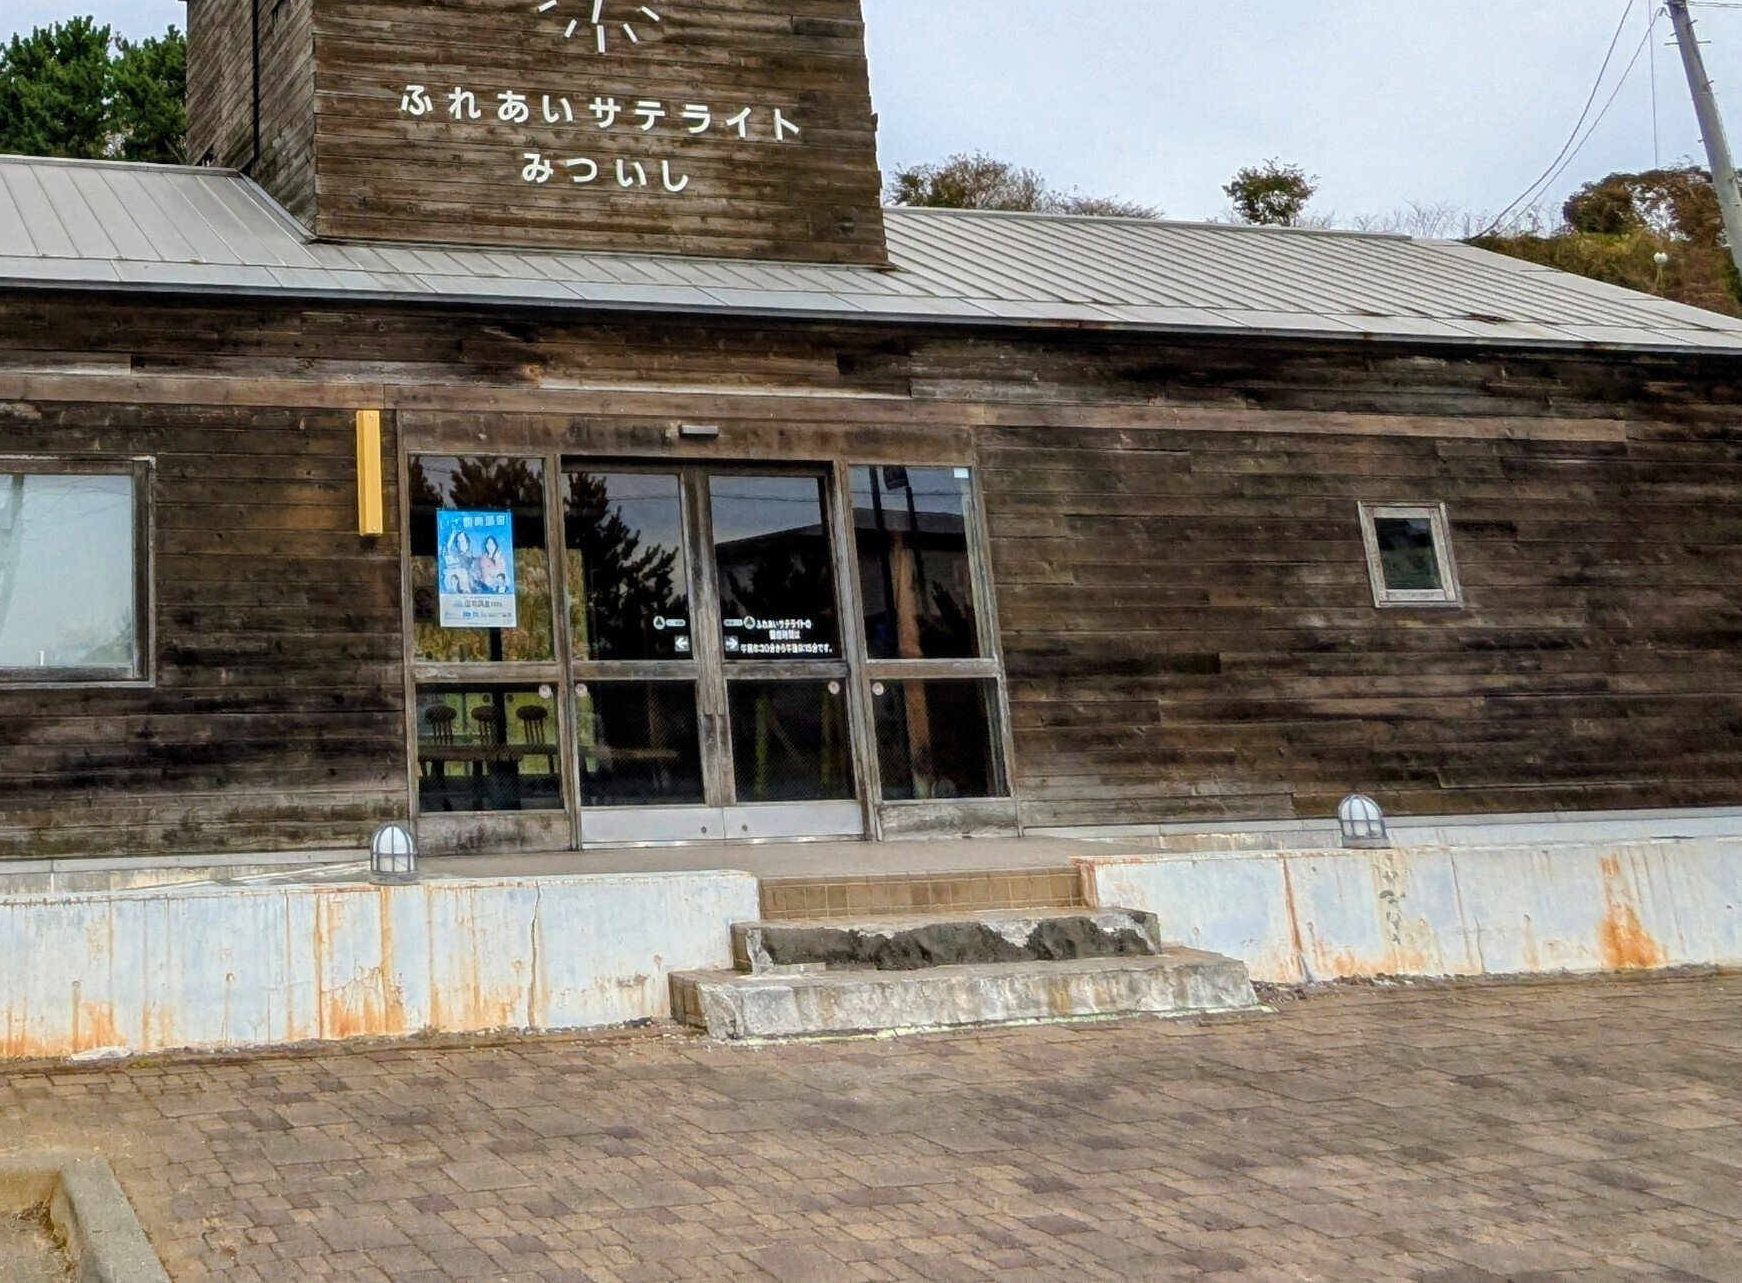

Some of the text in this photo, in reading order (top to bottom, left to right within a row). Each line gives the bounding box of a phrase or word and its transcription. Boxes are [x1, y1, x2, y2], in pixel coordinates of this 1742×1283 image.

[400, 84, 800, 142] ふれあいサテライト
[521, 152, 690, 193] みついし
